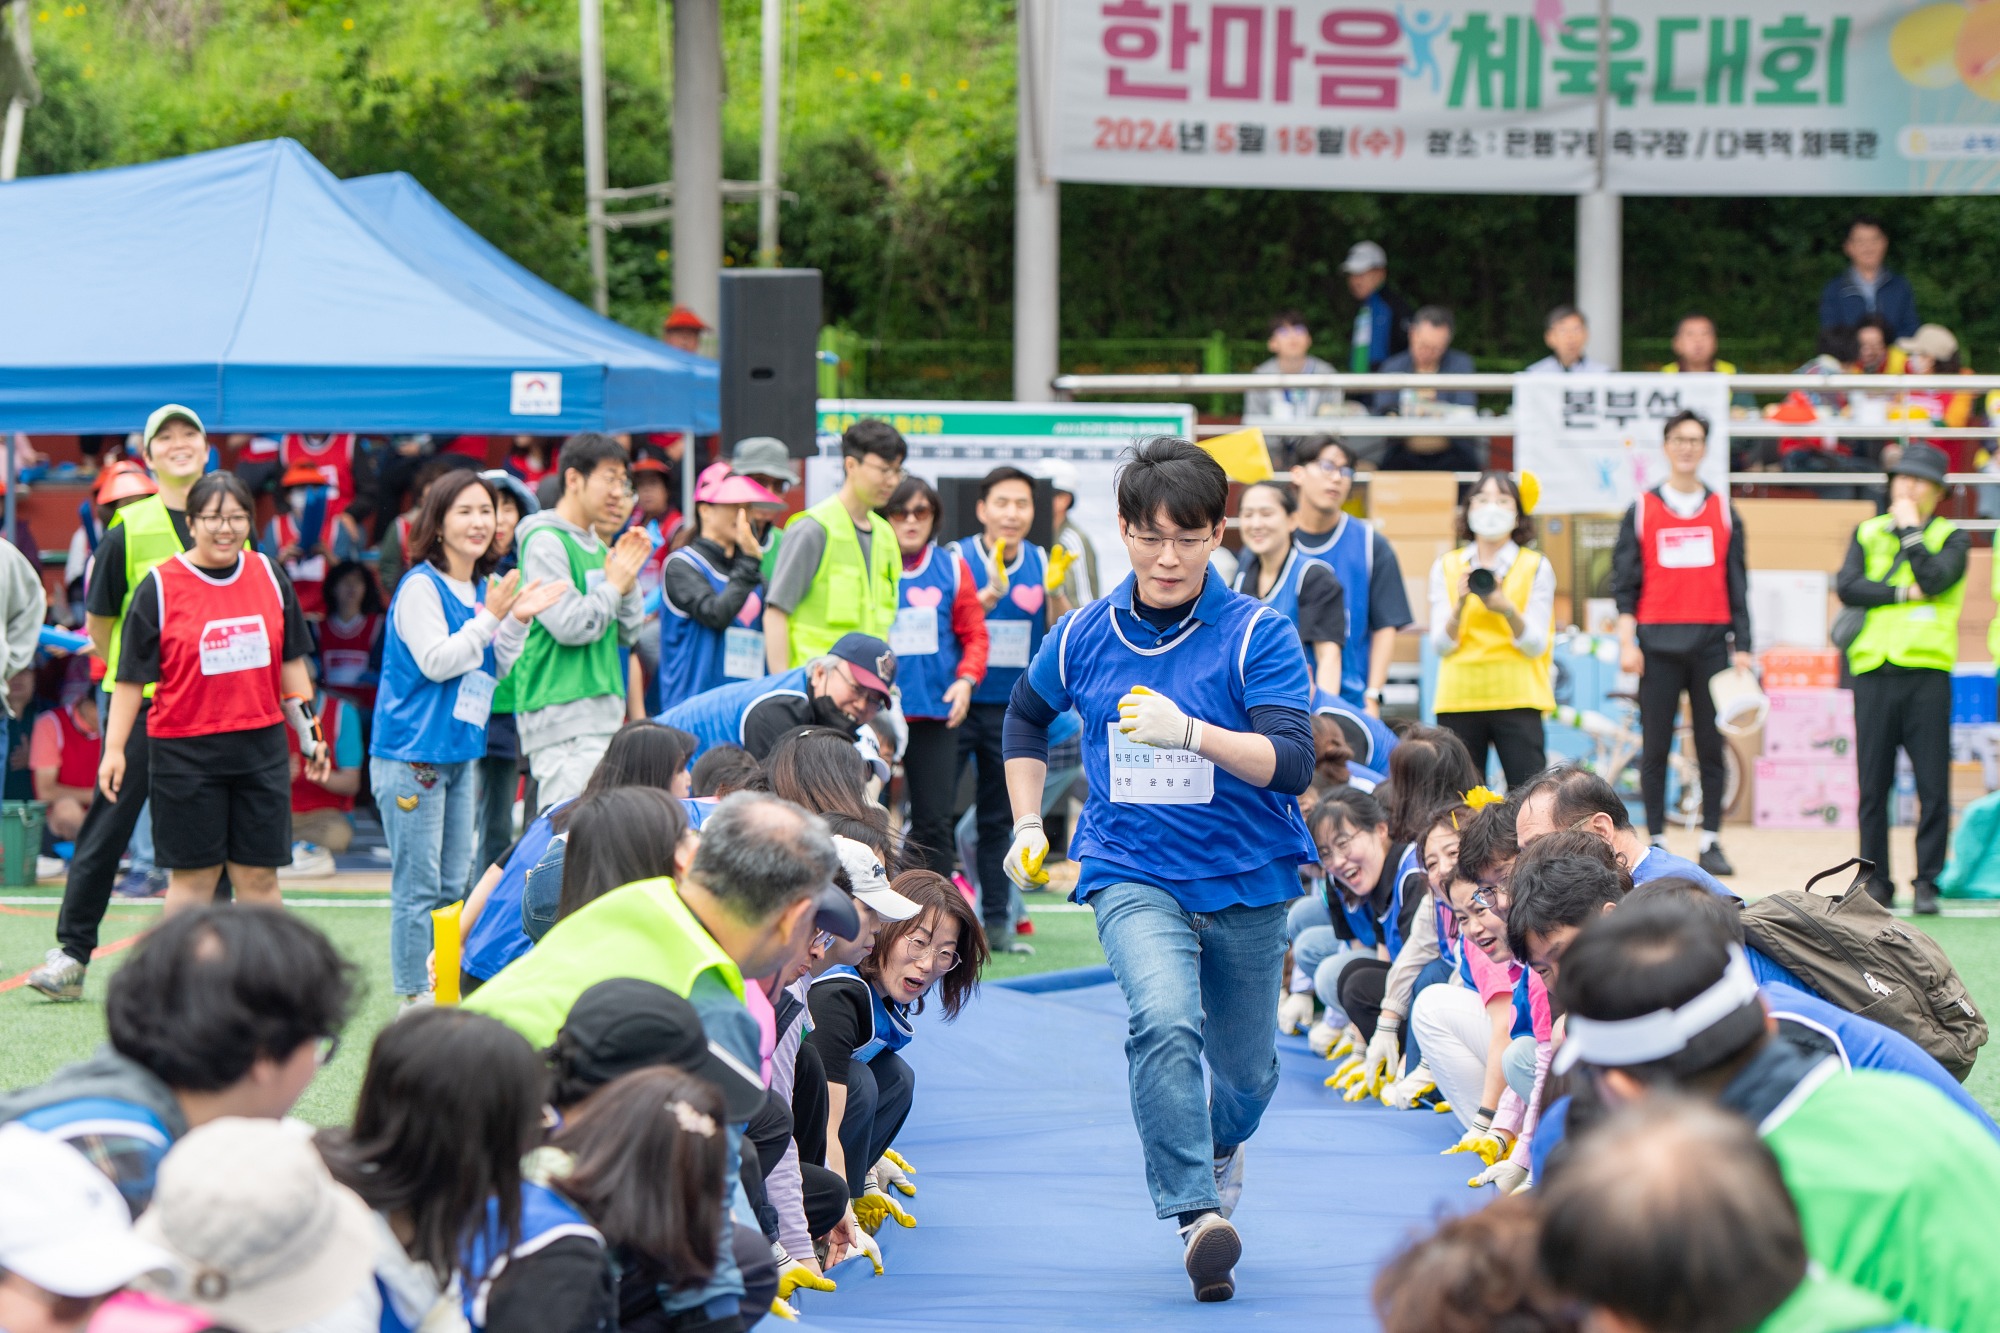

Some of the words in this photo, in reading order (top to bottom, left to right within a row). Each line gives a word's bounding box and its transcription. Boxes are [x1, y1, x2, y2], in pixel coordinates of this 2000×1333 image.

[1101, 0, 1406, 109] 한마음
[1446, 10, 1853, 111] 체육대회
[1094, 117, 1206, 154] 2024년
